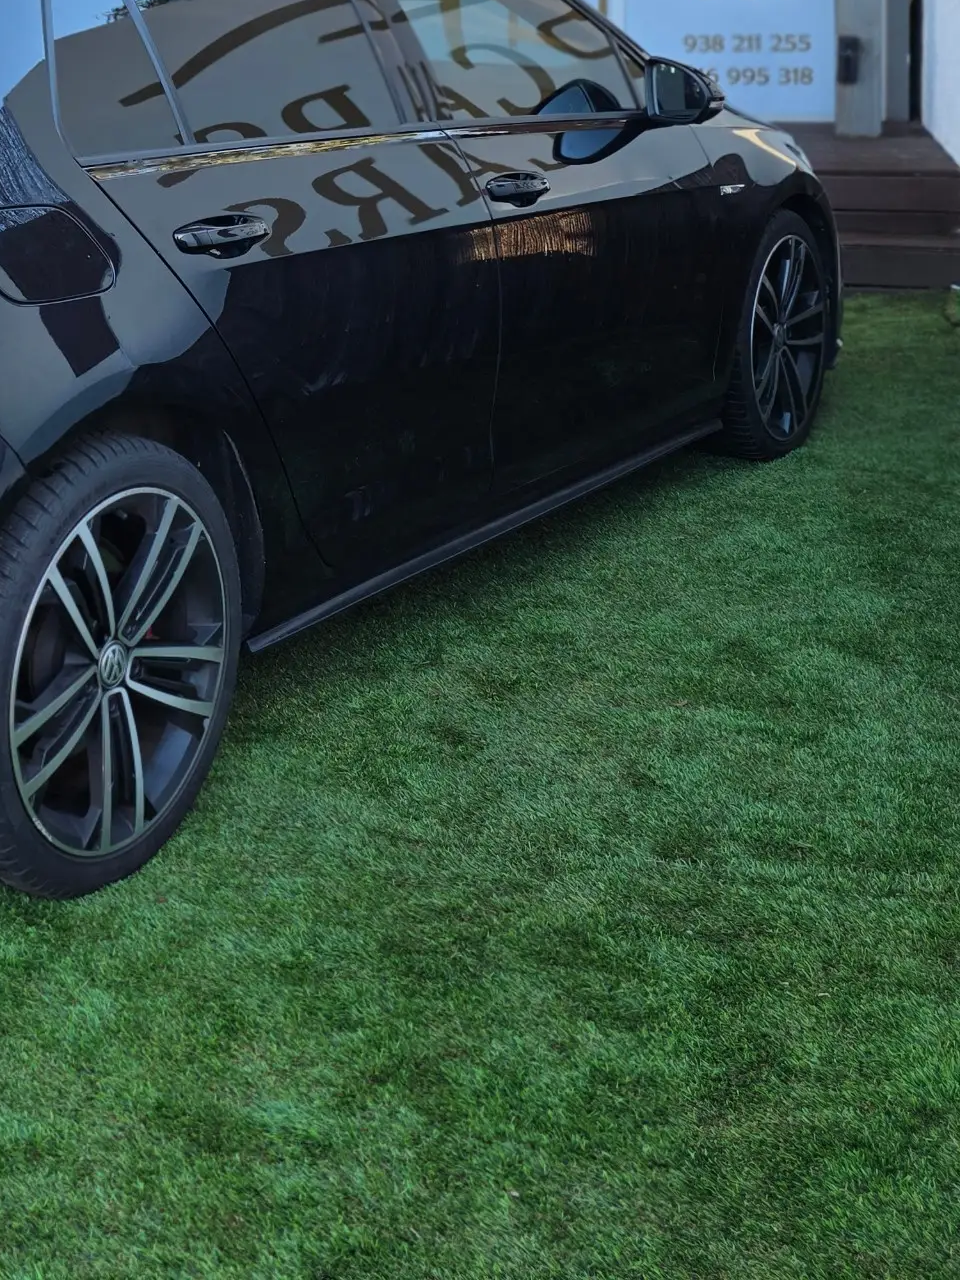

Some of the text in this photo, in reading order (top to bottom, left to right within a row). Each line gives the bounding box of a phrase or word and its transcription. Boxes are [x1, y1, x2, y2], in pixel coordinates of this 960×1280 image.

[683, 33, 812, 54] 938 211 255
[727, 67, 770, 86] 995
[778, 66, 814, 85] 318
